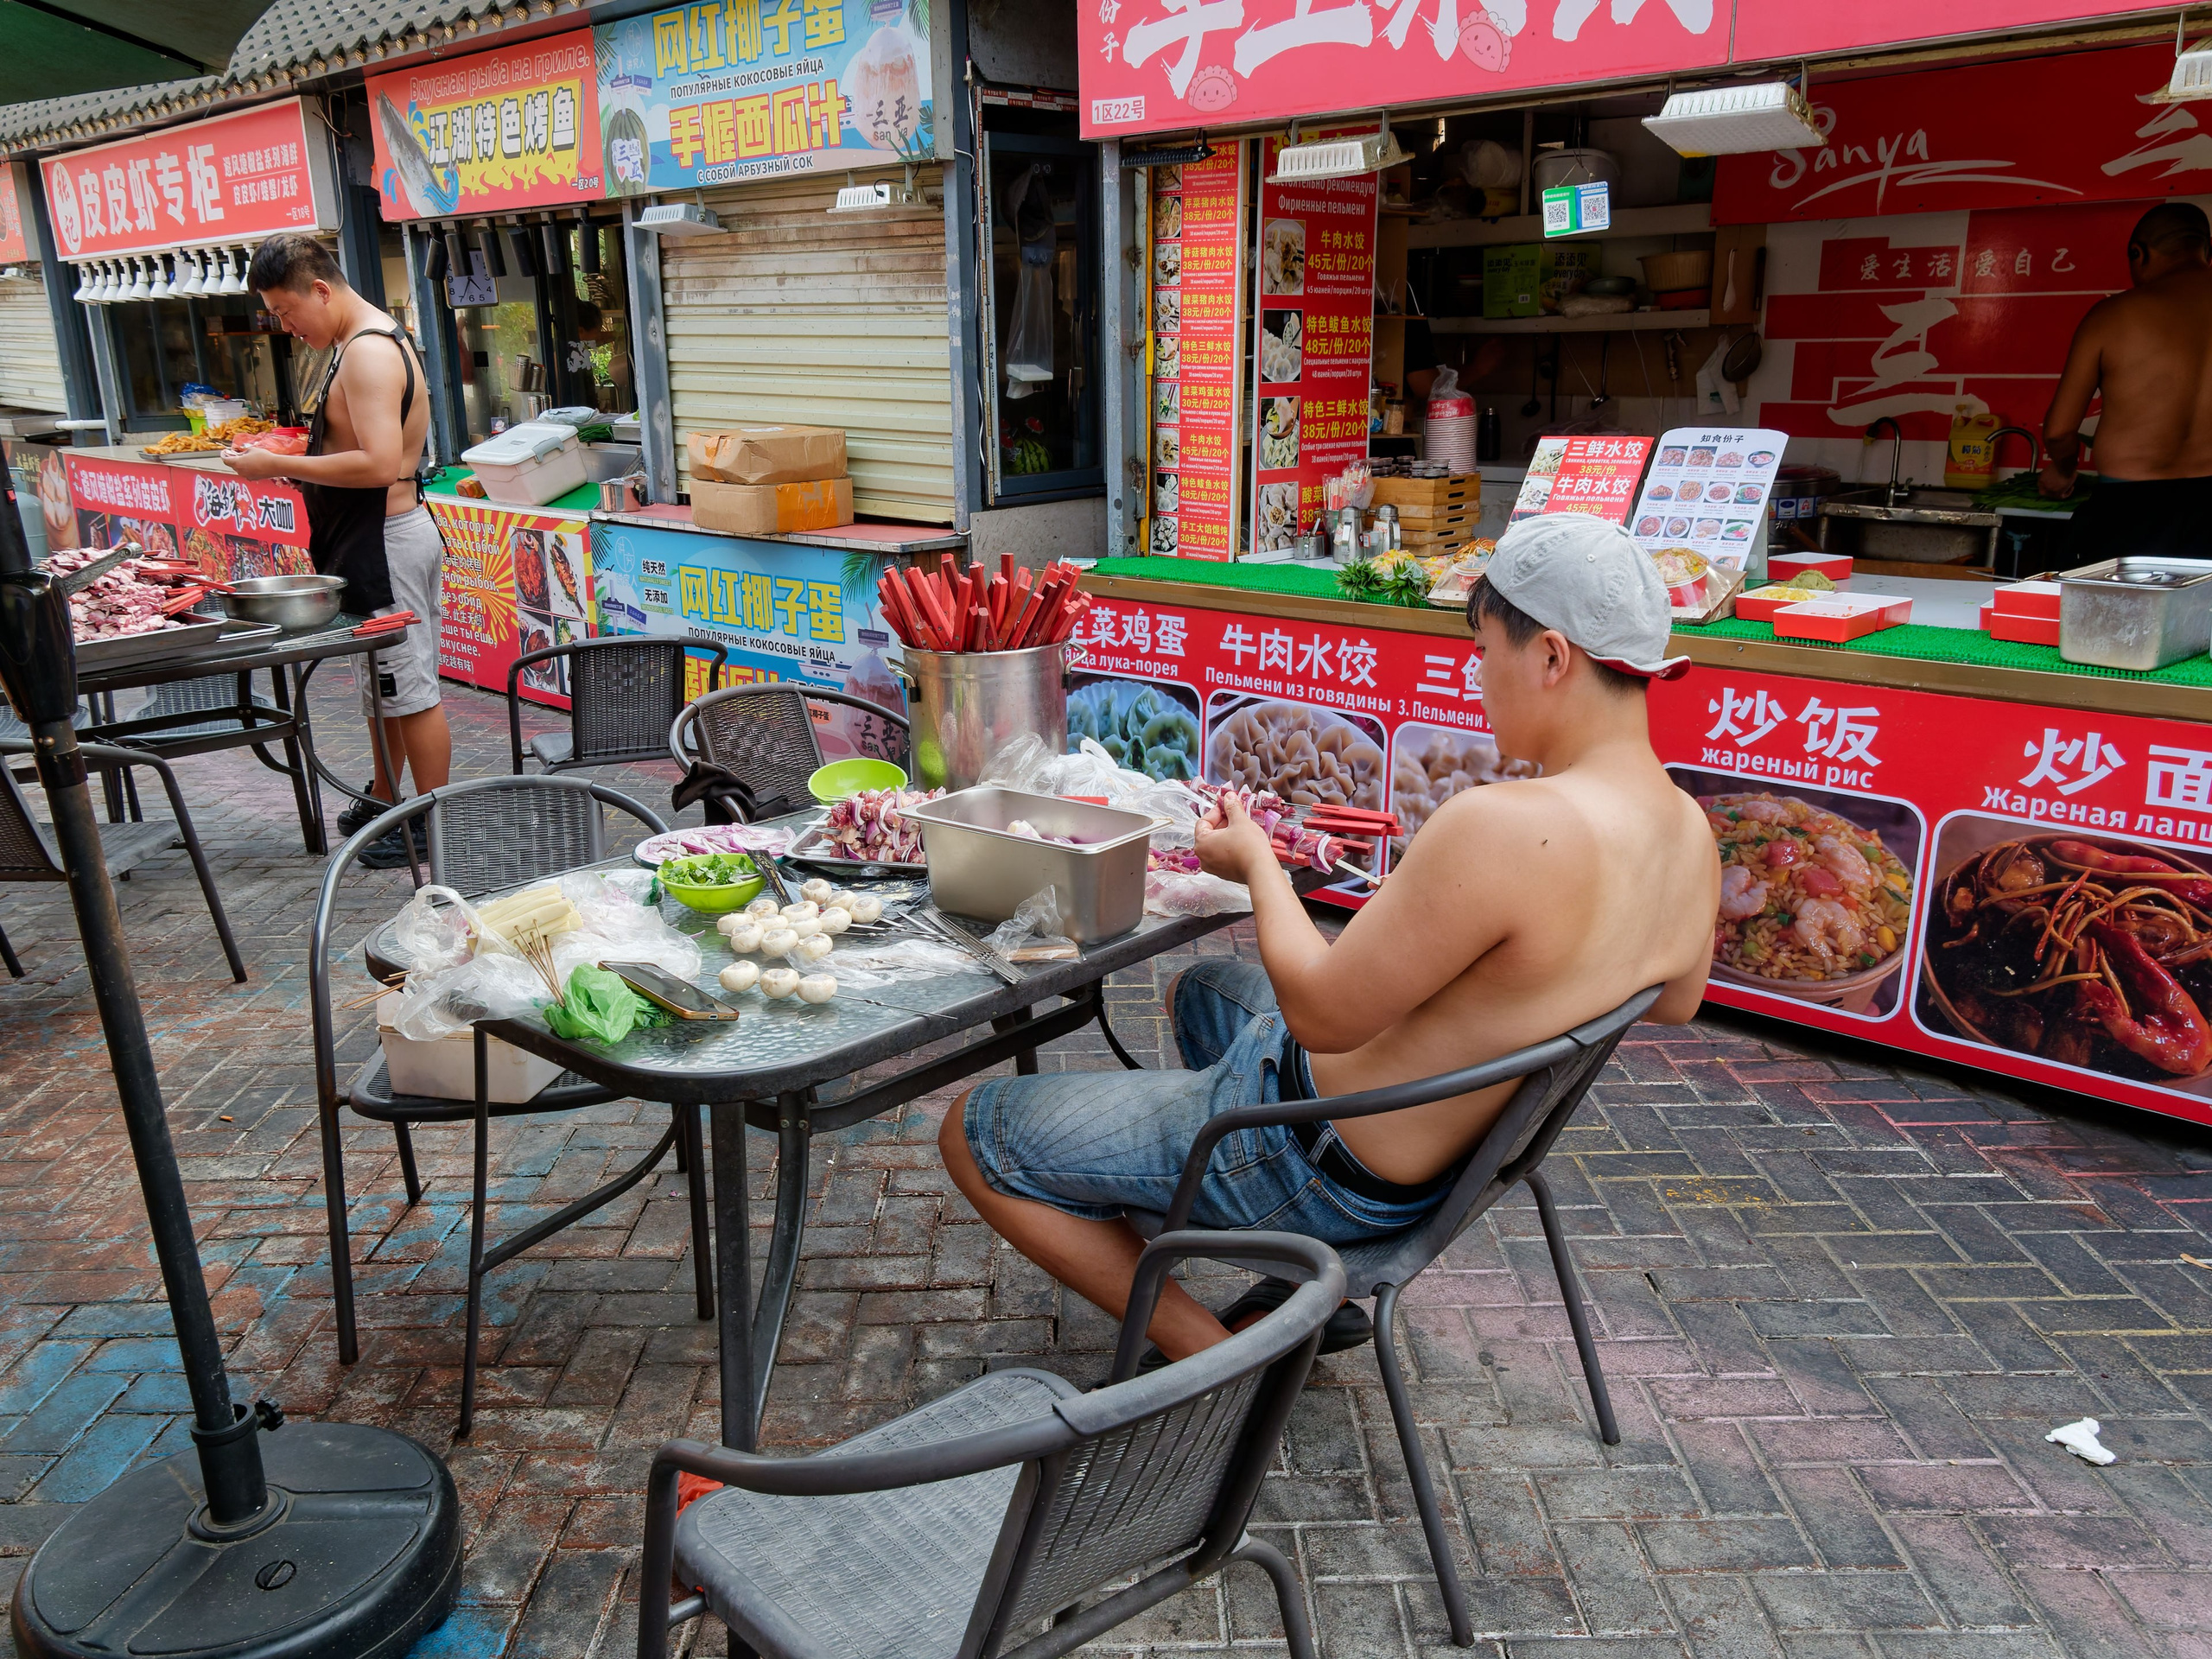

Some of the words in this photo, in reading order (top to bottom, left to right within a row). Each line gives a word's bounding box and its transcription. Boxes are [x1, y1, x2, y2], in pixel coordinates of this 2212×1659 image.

[410, 73, 466, 105] Вкусная
[469, 58, 508, 97] рыба
[512, 59, 531, 81] на
[535, 46, 590, 80] гриле.
[671, 75, 732, 99] ПОПУЛЯРНЫЕ
[734, 64, 793, 91] КОКОСОВЫЕ
[796, 57, 824, 79] ЯЙЦА
[1093, 98, 1144, 123] 1区22号
[429, 87, 575, 165] 江湖特色烤鱼
[669, 79, 846, 168] 手握西瓜汁
[706, 160, 736, 183] СОБОЙ
[738, 154, 791, 180] АРБУЗНЫЙ
[793, 156, 814, 172] СОК
[79, 143, 226, 238] 皮皮虾专柜
[1326, 179, 1375, 197] рекомендую
[1279, 194, 1326, 214] Фирменные
[1327, 201, 1365, 215] пельмени
[1184, 208, 1234, 221] 38元/份/20个
[1320, 230, 1364, 250] 牛肉水饺
[1183, 258, 1233, 270] 38元/份/20个
[1308, 252, 1374, 272] 45元/份/20个
[1860, 247, 2075, 282] 爱生活爱自己
[1182, 307, 1232, 317] 38元/份/20个
[1182, 340, 1231, 352] 特色三鲜水饺
[1305, 337, 1371, 355] 48元/份/20个
[1181, 353, 1230, 364] 38元/份/20个
[1182, 385, 1230, 397] 韭菜鸡蛋水饺
[1182, 398, 1230, 410] 30元/份/20个
[1304, 398, 1369, 419] 特色三鲜水饺
[1302, 419, 1368, 440] 38元/份/20个
[1700, 434, 1745, 444] 知食份子
[1190, 434, 1222, 446] 牛肉水饺
[1568, 440, 1643, 458] 三鲜水饺
[1181, 446, 1229, 459] 45元/份/20个
[1579, 465, 1618, 475] 38元/份
[1556, 476, 1632, 495] 牛肉水饺
[1181, 490, 1228, 503] 48元/份/20个
[1552, 493, 1585, 502] Говяжьи
[1586, 494, 1625, 503] пельмени
[1566, 504, 1604, 514] 45元/份
[452, 518, 496, 537] которую
[1181, 521, 1228, 536] 手工大馅馄饨
[471, 538, 501, 556] собой
[1180, 534, 1227, 548] 30元/份/20个
[642, 560, 666, 576] 纯天然
[464, 574, 499, 595] рыбой,
[459, 592, 483, 612] обид
[645, 588, 668, 604] 无添加
[678, 564, 845, 643] 网红椰子蛋
[440, 639, 481, 657] вкуснее.
[460, 628, 473, 639] ты
[474, 632, 498, 649] ешь,
[688, 626, 747, 647] ПОПУЛЯРНЫЕ
[749, 638, 807, 657] КОКОСОВЫЕ
[809, 646, 836, 664] ЯЙЦА
[1099, 654, 1179, 677] лука-порея
[1220, 624, 1378, 689] 牛肉水饺
[1205, 667, 1283, 695] Пельмени
[1287, 681, 1305, 696] из
[1308, 684, 1391, 713] говядины
[1398, 699, 1409, 716] 3.
[1412, 701, 1483, 728] Пельмени
[1706, 687, 1883, 767] 炒饭
[1700, 744, 1819, 780] жареный
[1825, 762, 1874, 790] рис
[1981, 785, 2127, 829] Жареная
